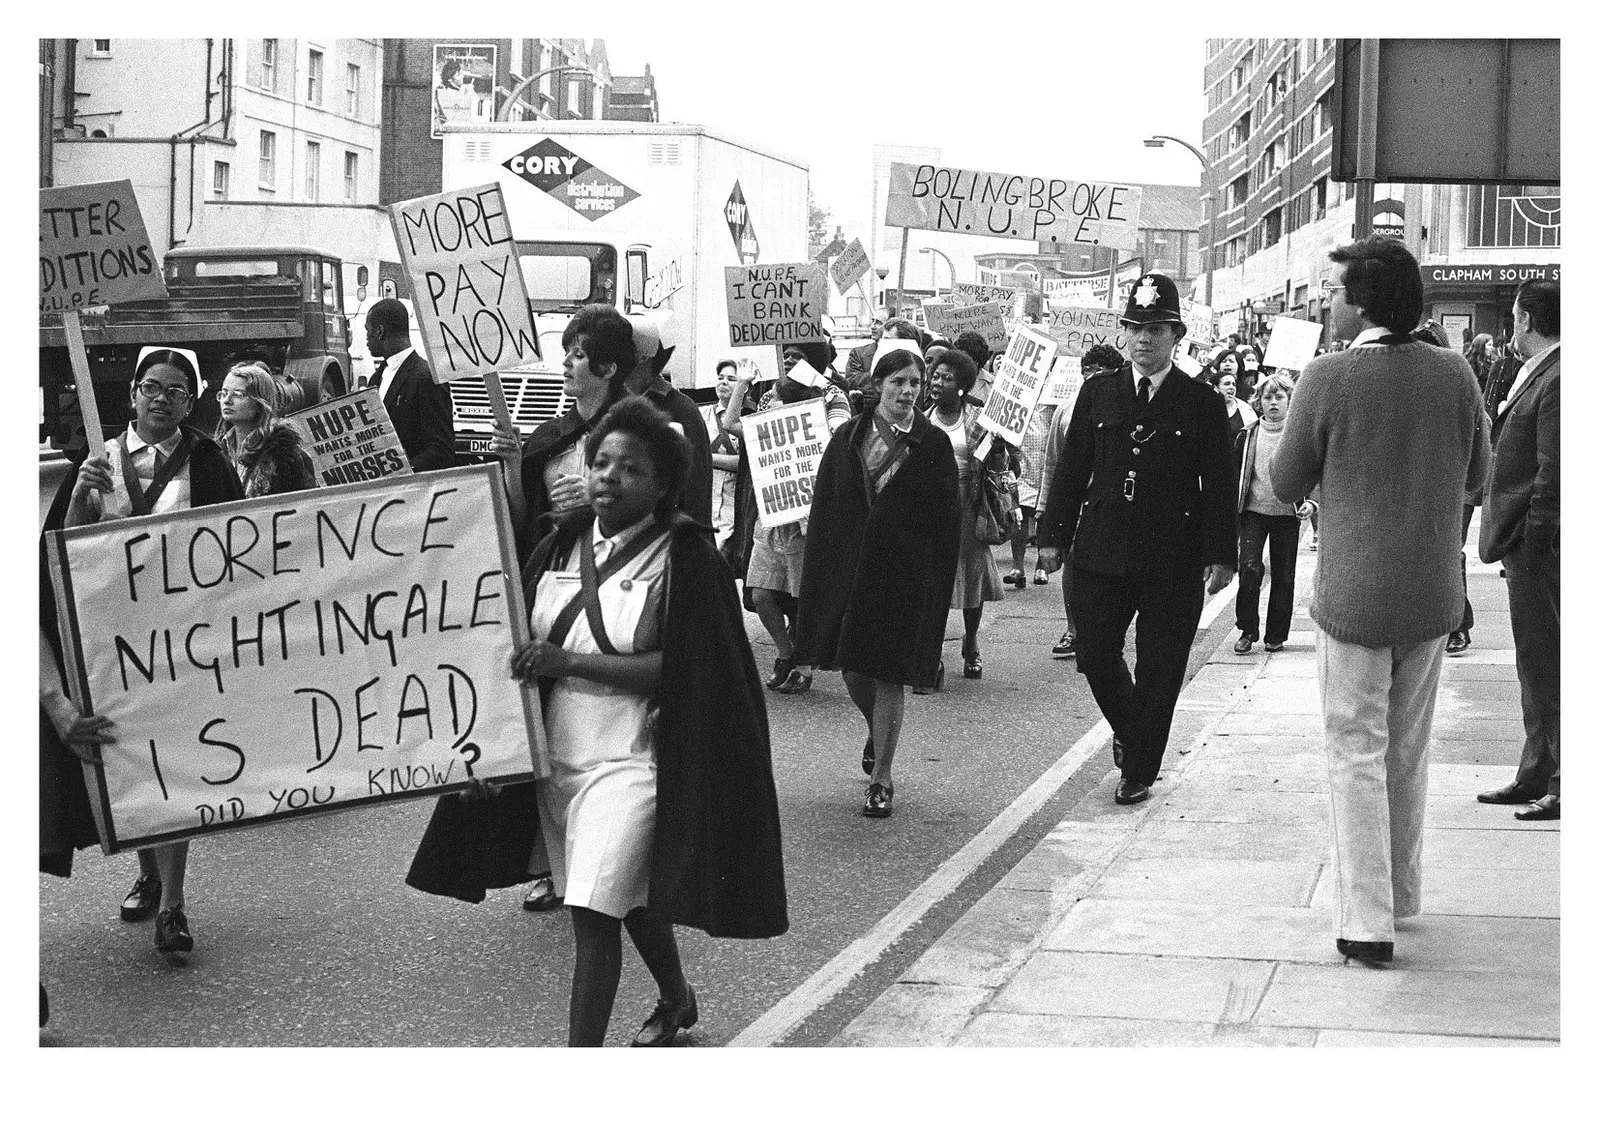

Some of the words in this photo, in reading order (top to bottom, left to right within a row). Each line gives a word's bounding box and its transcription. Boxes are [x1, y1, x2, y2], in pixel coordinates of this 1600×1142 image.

[510, 156, 579, 174] CORY
[567, 180, 614, 197] distribution
[912, 165, 1128, 221] BOLINGBROKE
[574, 198, 615, 210] services
[40, 200, 125, 241] TTER
[402, 188, 513, 256] MORE
[1373, 228, 1405, 236] DERGROU
[40, 245, 152, 292] DITIONS
[1433, 269, 1492, 281] CLAPHAM
[1500, 269, 1546, 281] SOUTH
[1552, 269, 1560, 281] S
[425, 255, 509, 317] PAY
[733, 283, 746, 299] I
[751, 275, 809, 299] CAN'T
[960, 285, 987, 296] MORE
[991, 288, 1014, 301] PAY
[753, 302, 811, 319] BANK
[970, 316, 999, 330] WANT
[439, 308, 541, 371] NOW
[730, 321, 821, 343] DEDICATION
[987, 332, 1006, 341] PAY
[1067, 332, 1107, 349] PAY
[1009, 333, 1046, 374] NUPE
[1009, 384, 1024, 400] THE
[1017, 371, 1039, 390] MORE
[306, 400, 376, 442] NUPE
[984, 389, 1029, 435] NURSES
[313, 436, 352, 455] WANTS
[354, 424, 385, 443] MORE
[756, 412, 816, 452] NUPE
[332, 449, 354, 463] FOR
[356, 441, 377, 456] THE
[758, 449, 792, 468] WANTS
[795, 442, 824, 458] MORE
[321, 448, 404, 487] NURSES
[773, 465, 792, 480] FOR
[795, 460, 813, 474] THE
[761, 475, 817, 515] NURS
[125, 489, 458, 602] FLORENCE
[114, 571, 502, 693] NIGHTINGALE
[149, 718, 246, 801] IS
[294, 664, 478, 773] DEAD
[195, 797, 245, 826] DID
[269, 786, 336, 814] YOU
